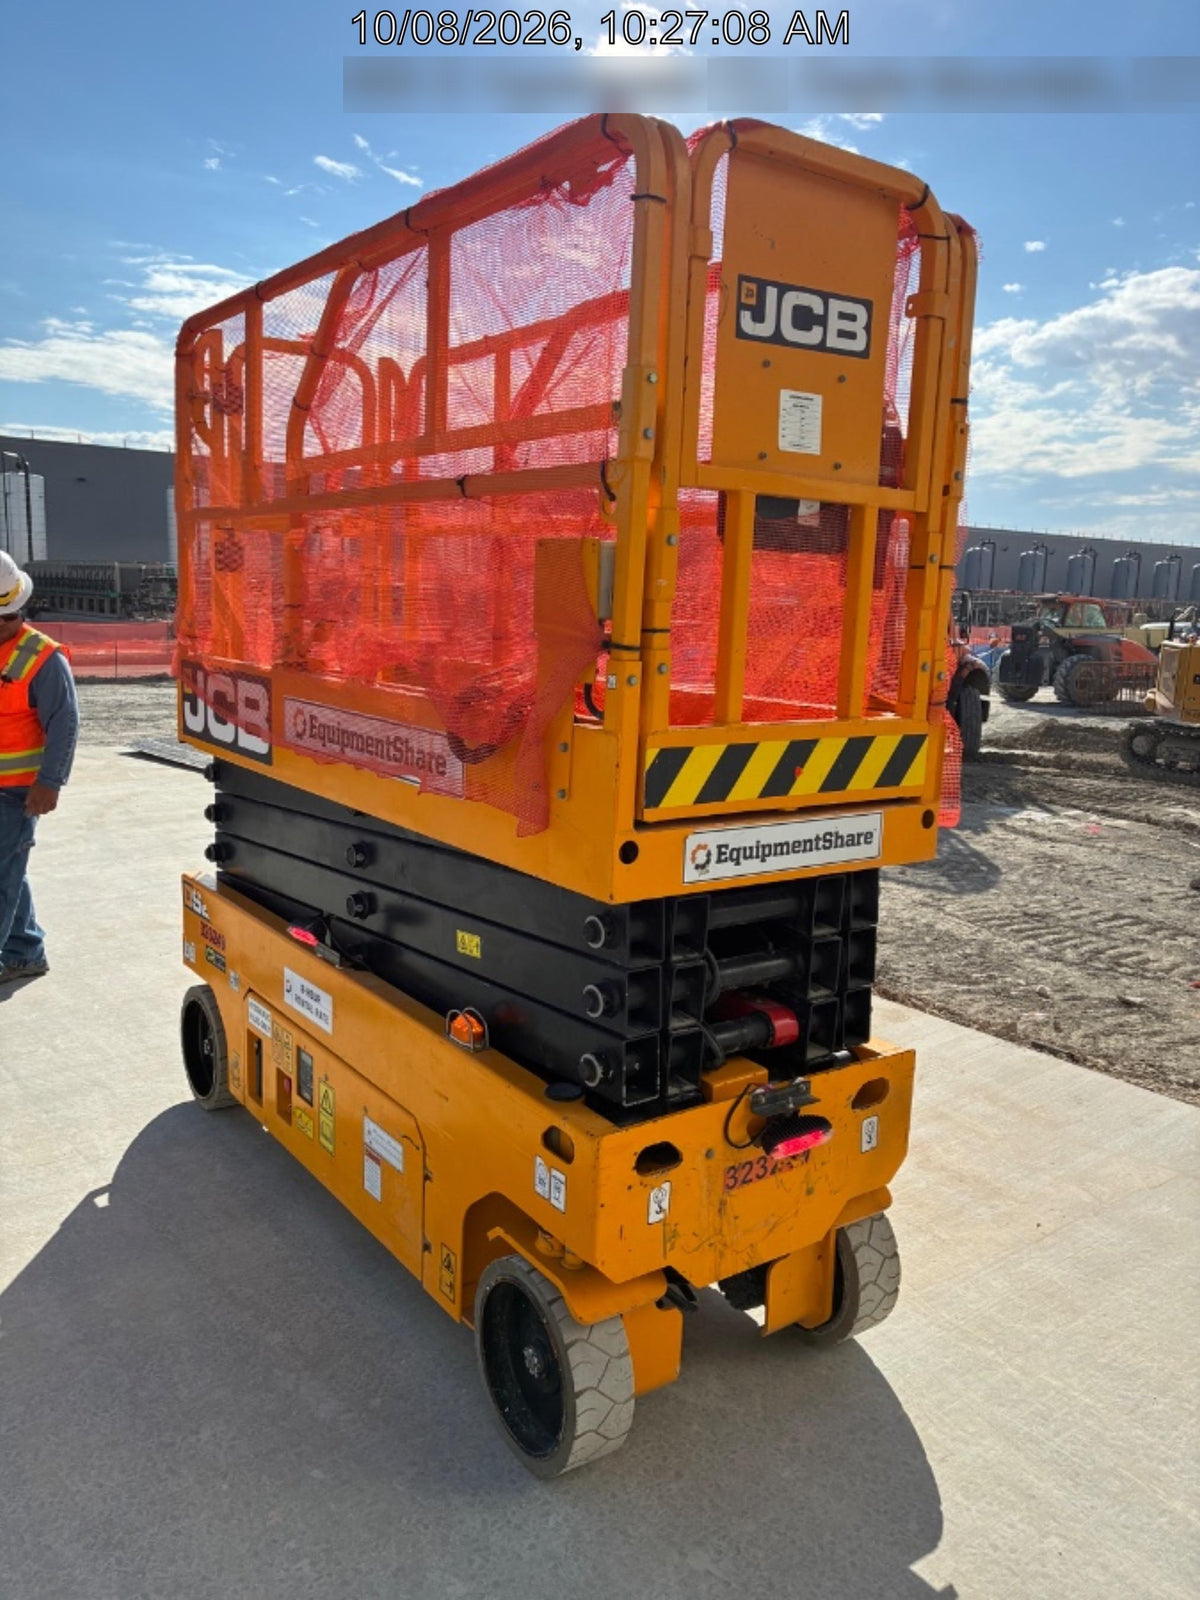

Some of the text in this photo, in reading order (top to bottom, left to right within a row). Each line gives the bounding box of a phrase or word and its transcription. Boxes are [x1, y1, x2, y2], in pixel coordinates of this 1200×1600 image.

[740, 285, 868, 352] JCB
[184, 669, 270, 755] JCB
[308, 713, 447, 777] EquipmentShare
[715, 829, 875, 867] EquipmentShare
